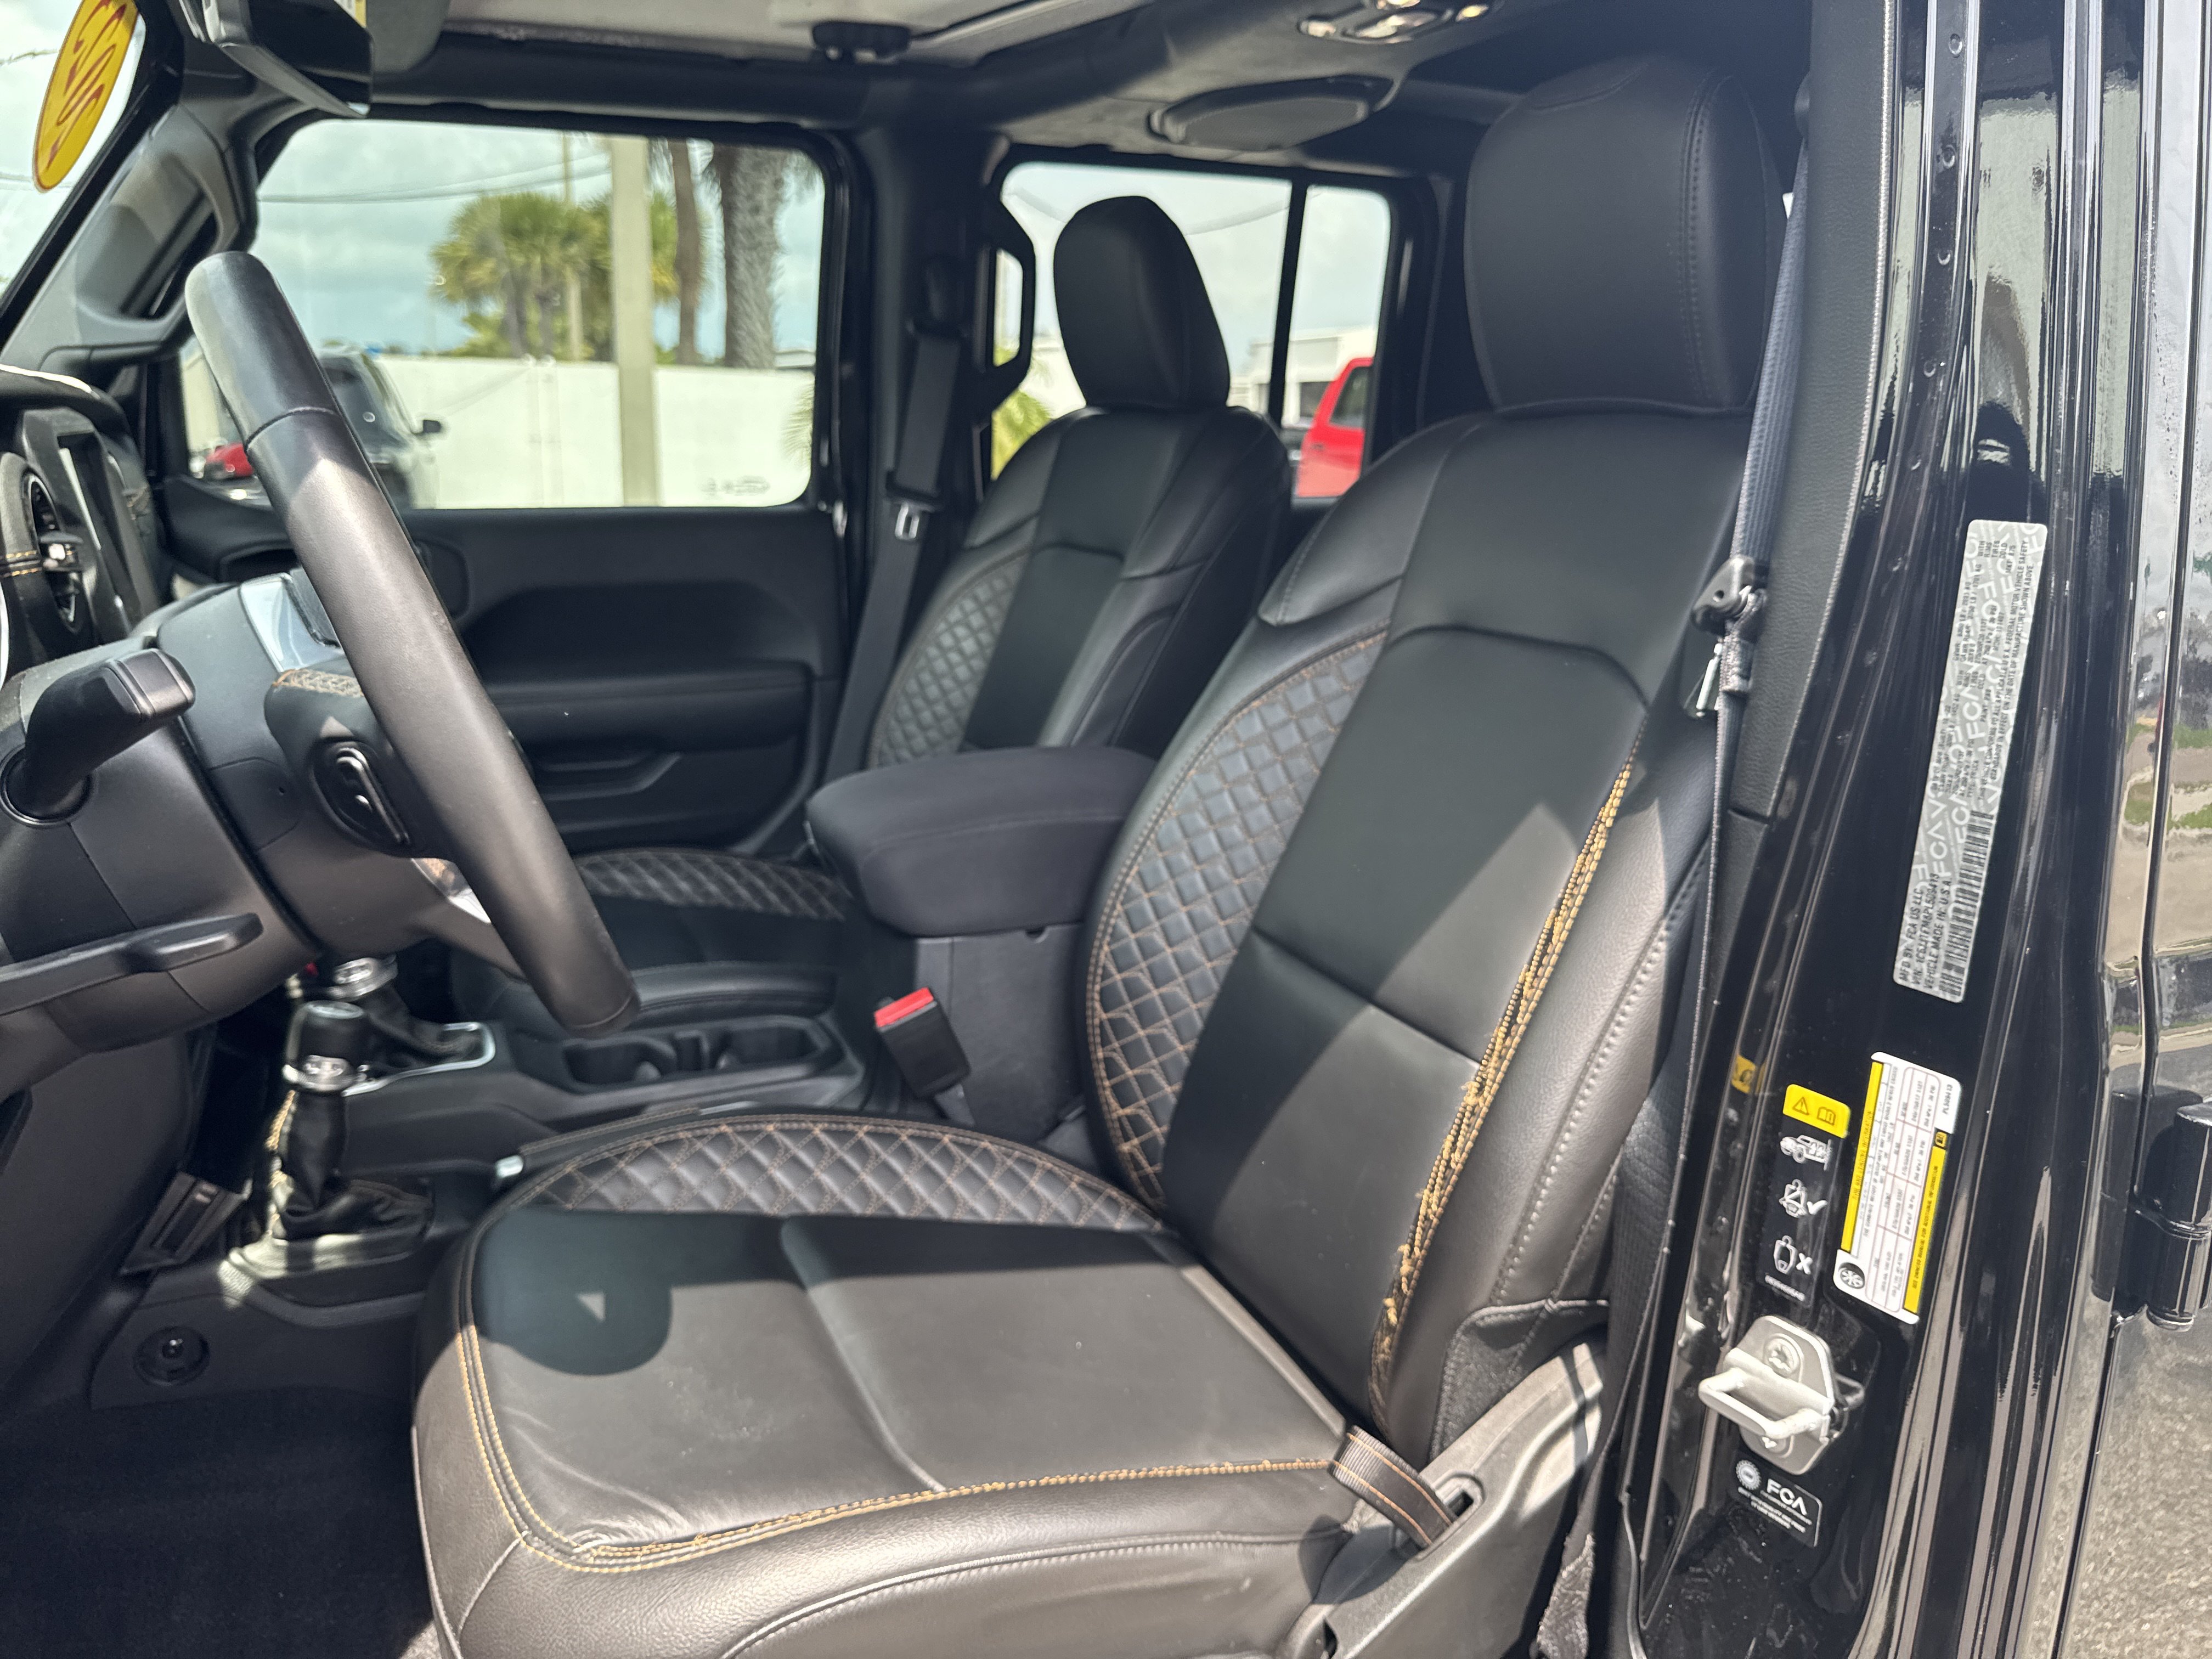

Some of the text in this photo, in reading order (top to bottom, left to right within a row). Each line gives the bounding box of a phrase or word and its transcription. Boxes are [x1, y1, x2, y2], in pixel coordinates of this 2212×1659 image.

[1984, 541, 1992, 557] RIMS
[1991, 540, 2000, 558] TIRES
[1999, 543, 2007, 558] COLD
[2018, 540, 2029, 564] SAFETY
[2013, 565, 2024, 591] VEHICLE
[2010, 592, 2019, 614] MOTOR
[2005, 617, 2016, 645] FEDERAL
[2011, 612, 2025, 658] MANUFACTURE
[2019, 586, 2030, 611] SHOWN
[1911, 888, 1923, 905] LLC
[1909, 906, 1920, 920] US
[1905, 922, 1917, 939] FCA
[1923, 951, 1938, 990] VEHICLE
[1931, 921, 1944, 950] MADE
[1767, 1479, 1807, 1516] FCA
